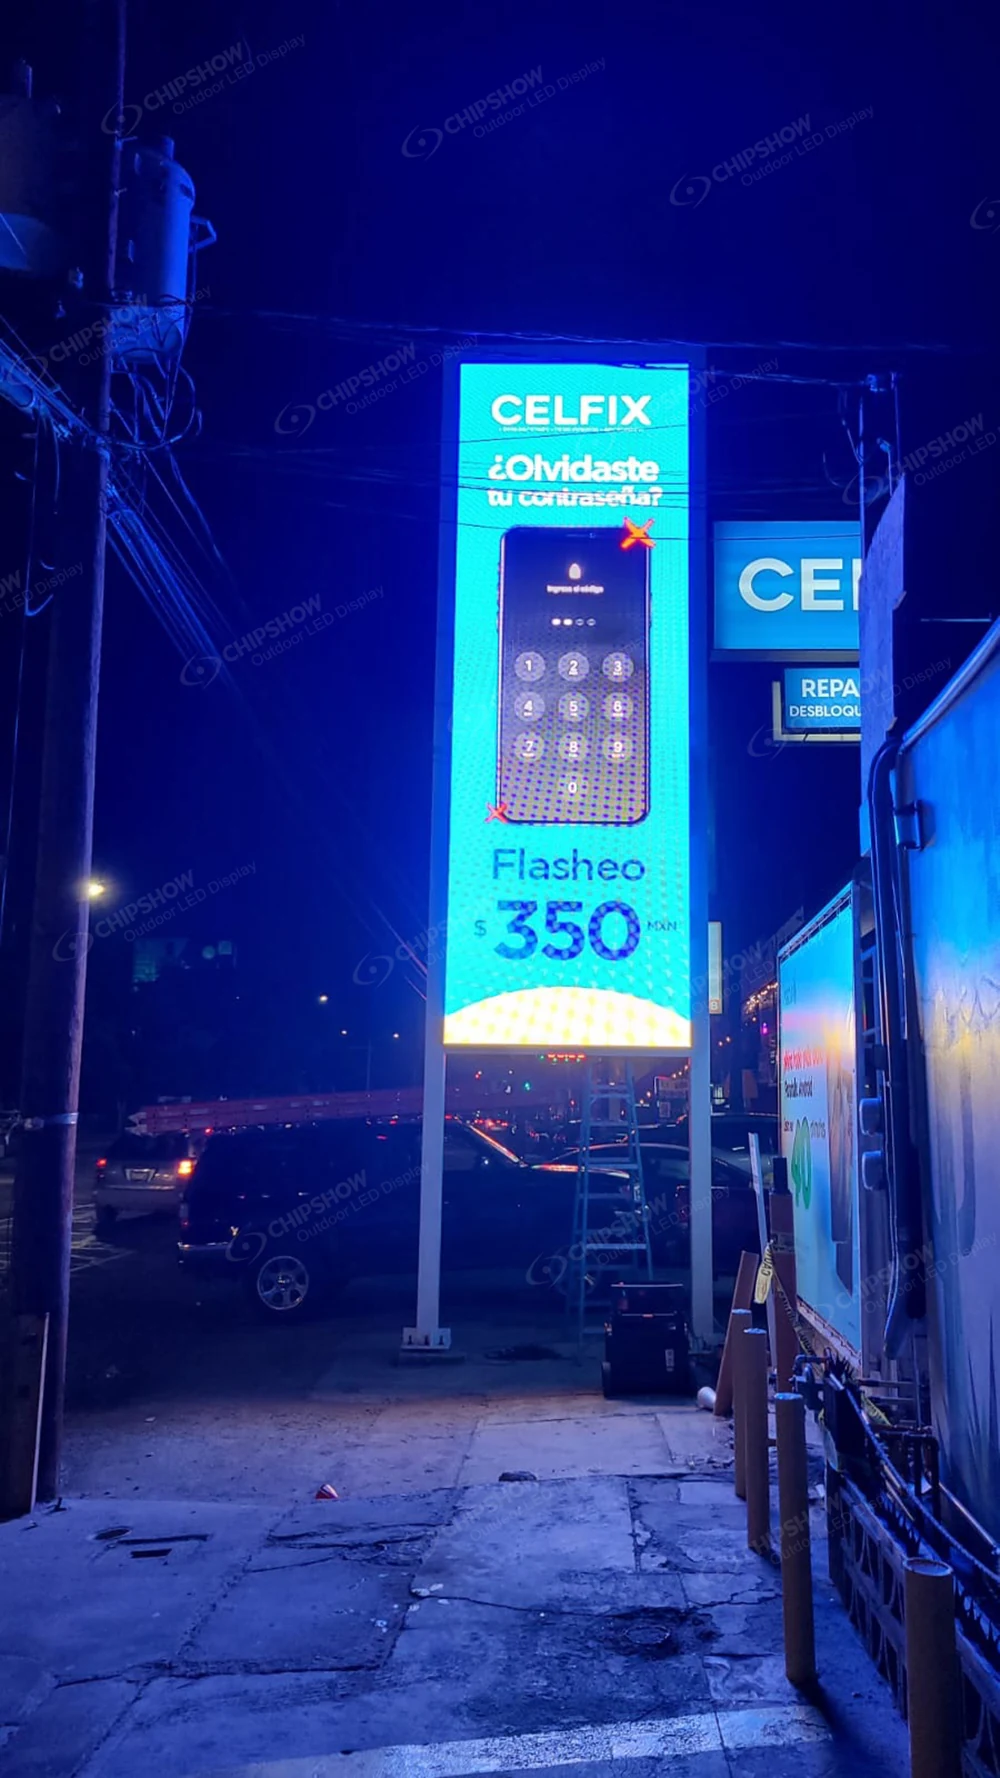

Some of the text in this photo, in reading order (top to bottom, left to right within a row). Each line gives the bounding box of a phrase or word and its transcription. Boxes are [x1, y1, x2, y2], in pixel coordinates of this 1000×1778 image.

[491, 395, 652, 426] CELFIX
[488, 454, 660, 481] ¿Olvidaste
[487, 486, 663, 507] tu contraseña?
[525, 660, 622, 672] 1 2 3
[801, 678, 861, 698] REPA
[523, 700, 622, 712] 4 5 6
[525, 740, 622, 753] 7 8 9
[568, 781, 577, 794] 0
[492, 848, 645, 881] Flasheo
[493, 900, 641, 961] 350
[647, 920, 678, 932] MXN
